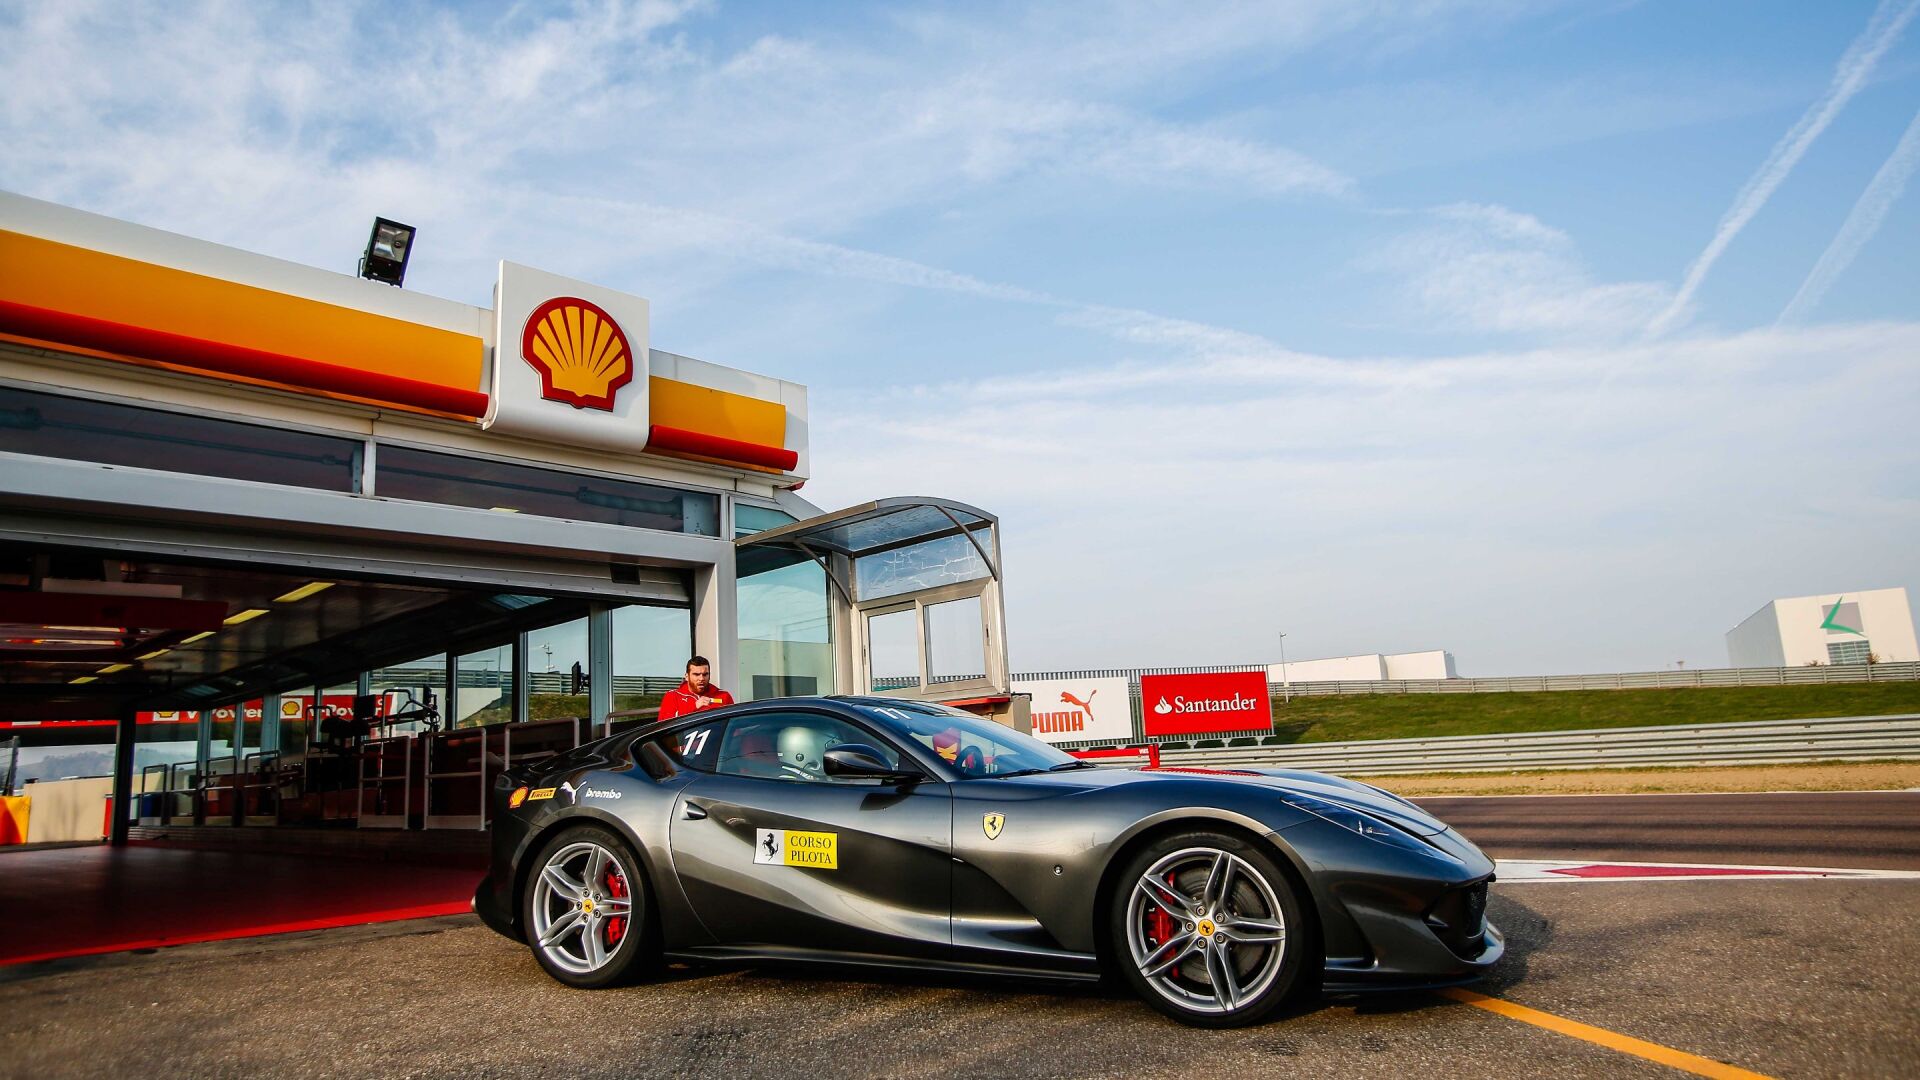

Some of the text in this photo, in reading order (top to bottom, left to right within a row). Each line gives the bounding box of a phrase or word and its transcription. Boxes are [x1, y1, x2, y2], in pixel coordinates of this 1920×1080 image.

[1174, 691, 1257, 714] Santander
[682, 729, 711, 756] 11
[585, 787, 622, 799] brembo
[790, 835, 832, 849] CORSO
[790, 850, 832, 864] PILOTA
